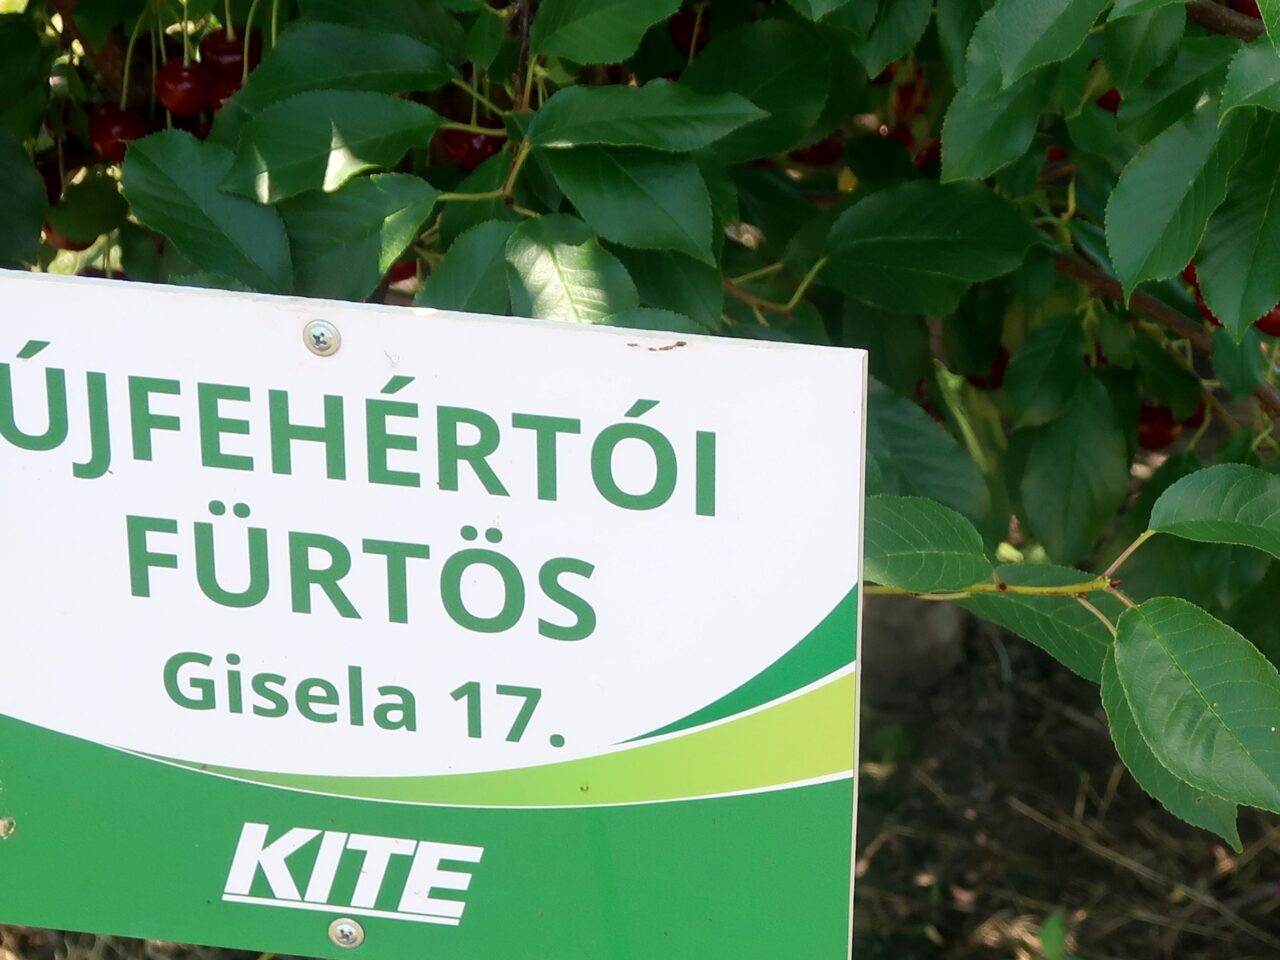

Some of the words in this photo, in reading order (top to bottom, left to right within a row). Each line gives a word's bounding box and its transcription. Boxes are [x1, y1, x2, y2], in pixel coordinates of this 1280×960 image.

[0, 339, 719, 517] ÚJFEHÉRTÓI
[126, 500, 598, 642] FÜRTÖS
[163, 651, 418, 732] Gisela
[449, 682, 566, 748] 17.
[223, 822, 485, 919] KITE
